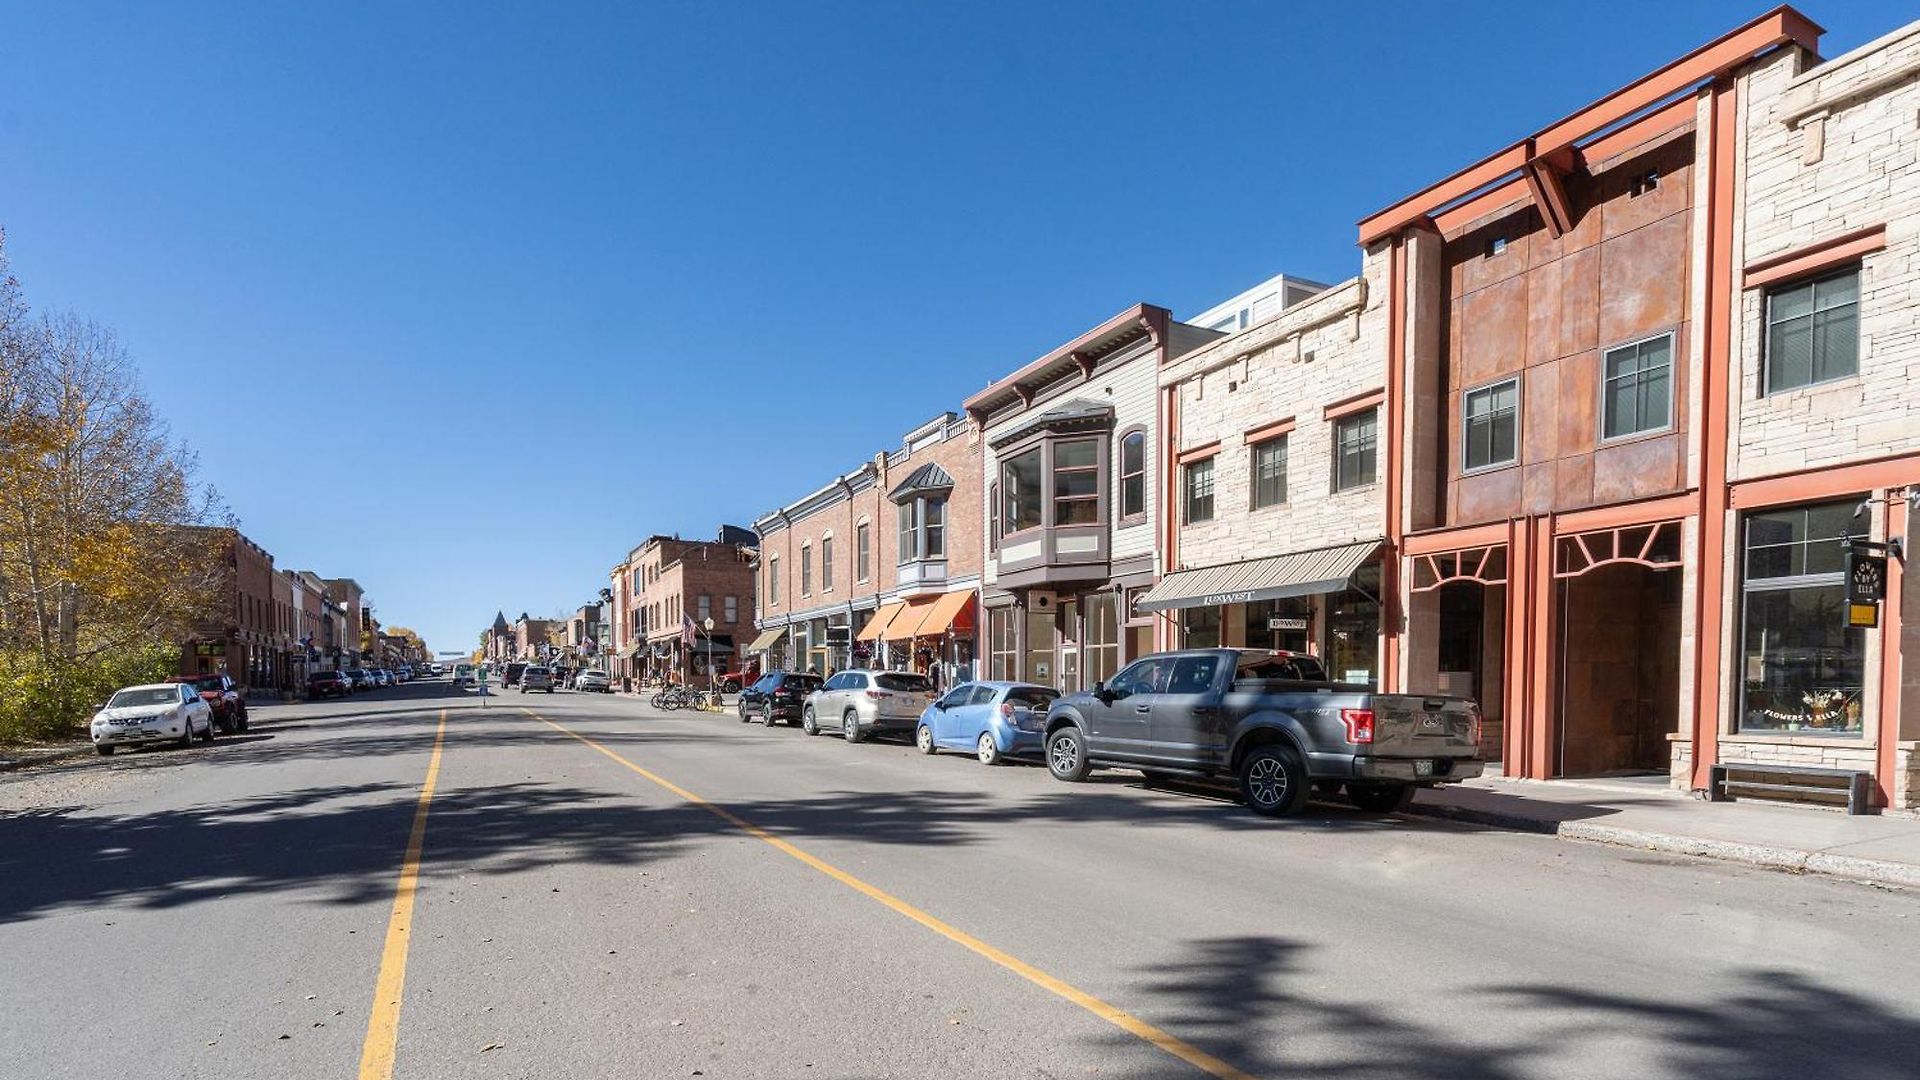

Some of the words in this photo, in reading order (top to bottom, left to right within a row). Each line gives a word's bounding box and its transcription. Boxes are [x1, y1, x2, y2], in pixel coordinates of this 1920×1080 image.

[1862, 574, 1871, 583] BY
[1859, 585, 1873, 593] ELLA
[1764, 709, 1804, 721] FLOWERS
